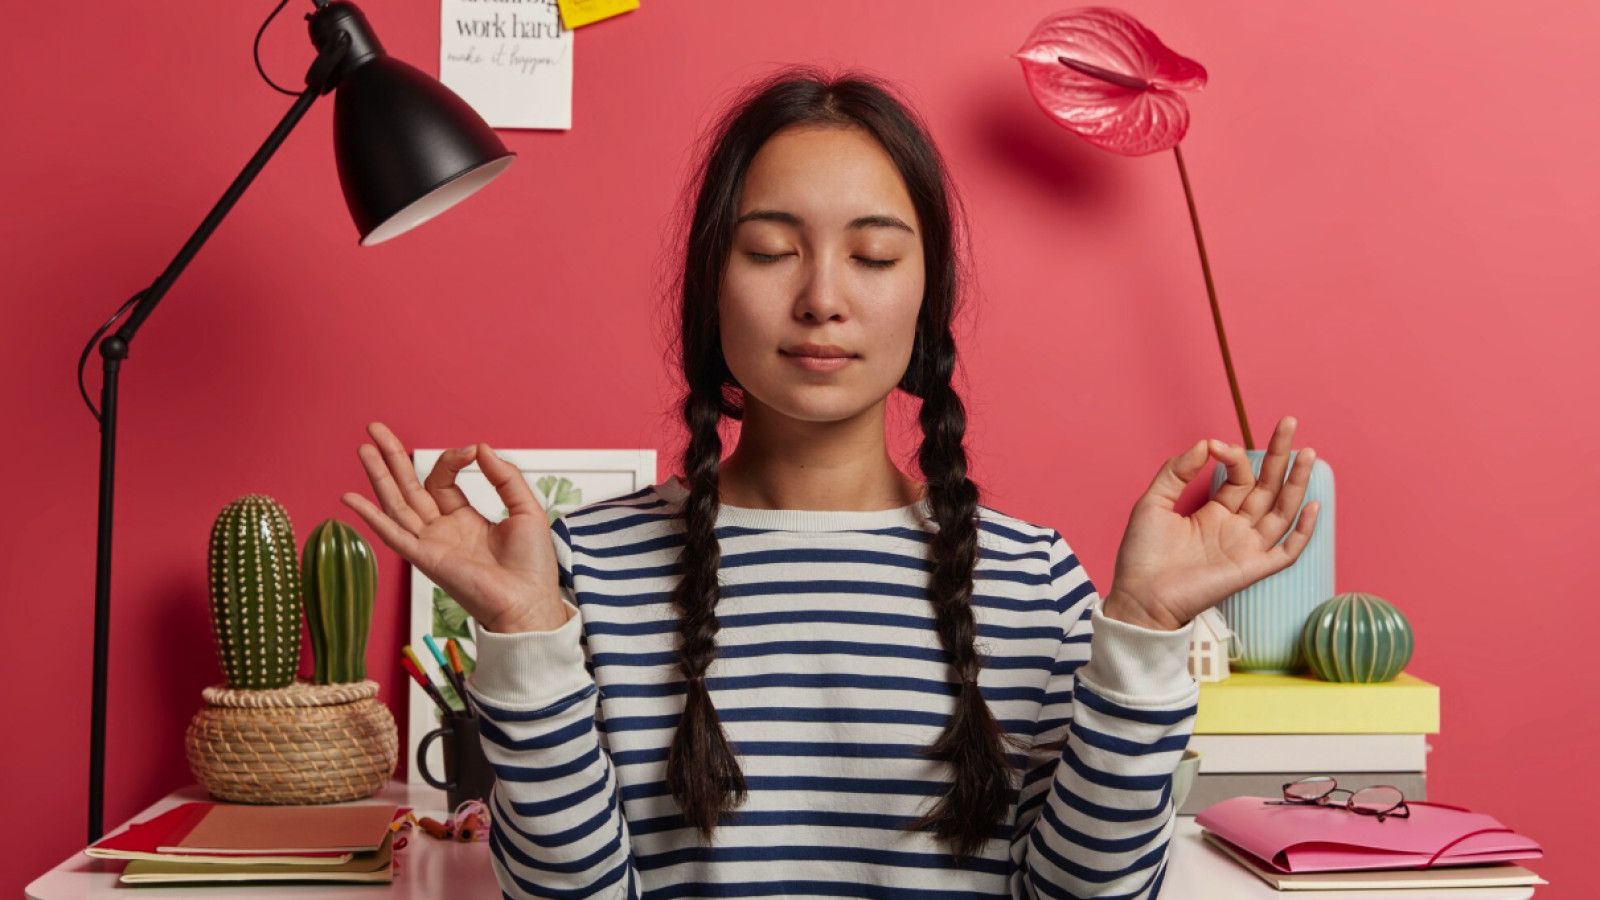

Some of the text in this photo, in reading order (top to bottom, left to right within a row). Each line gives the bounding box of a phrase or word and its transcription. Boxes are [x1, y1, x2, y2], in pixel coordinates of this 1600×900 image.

[456, 12, 561, 39] work hard
[447, 45, 482, 65] make
[491, 43, 507, 66] it
